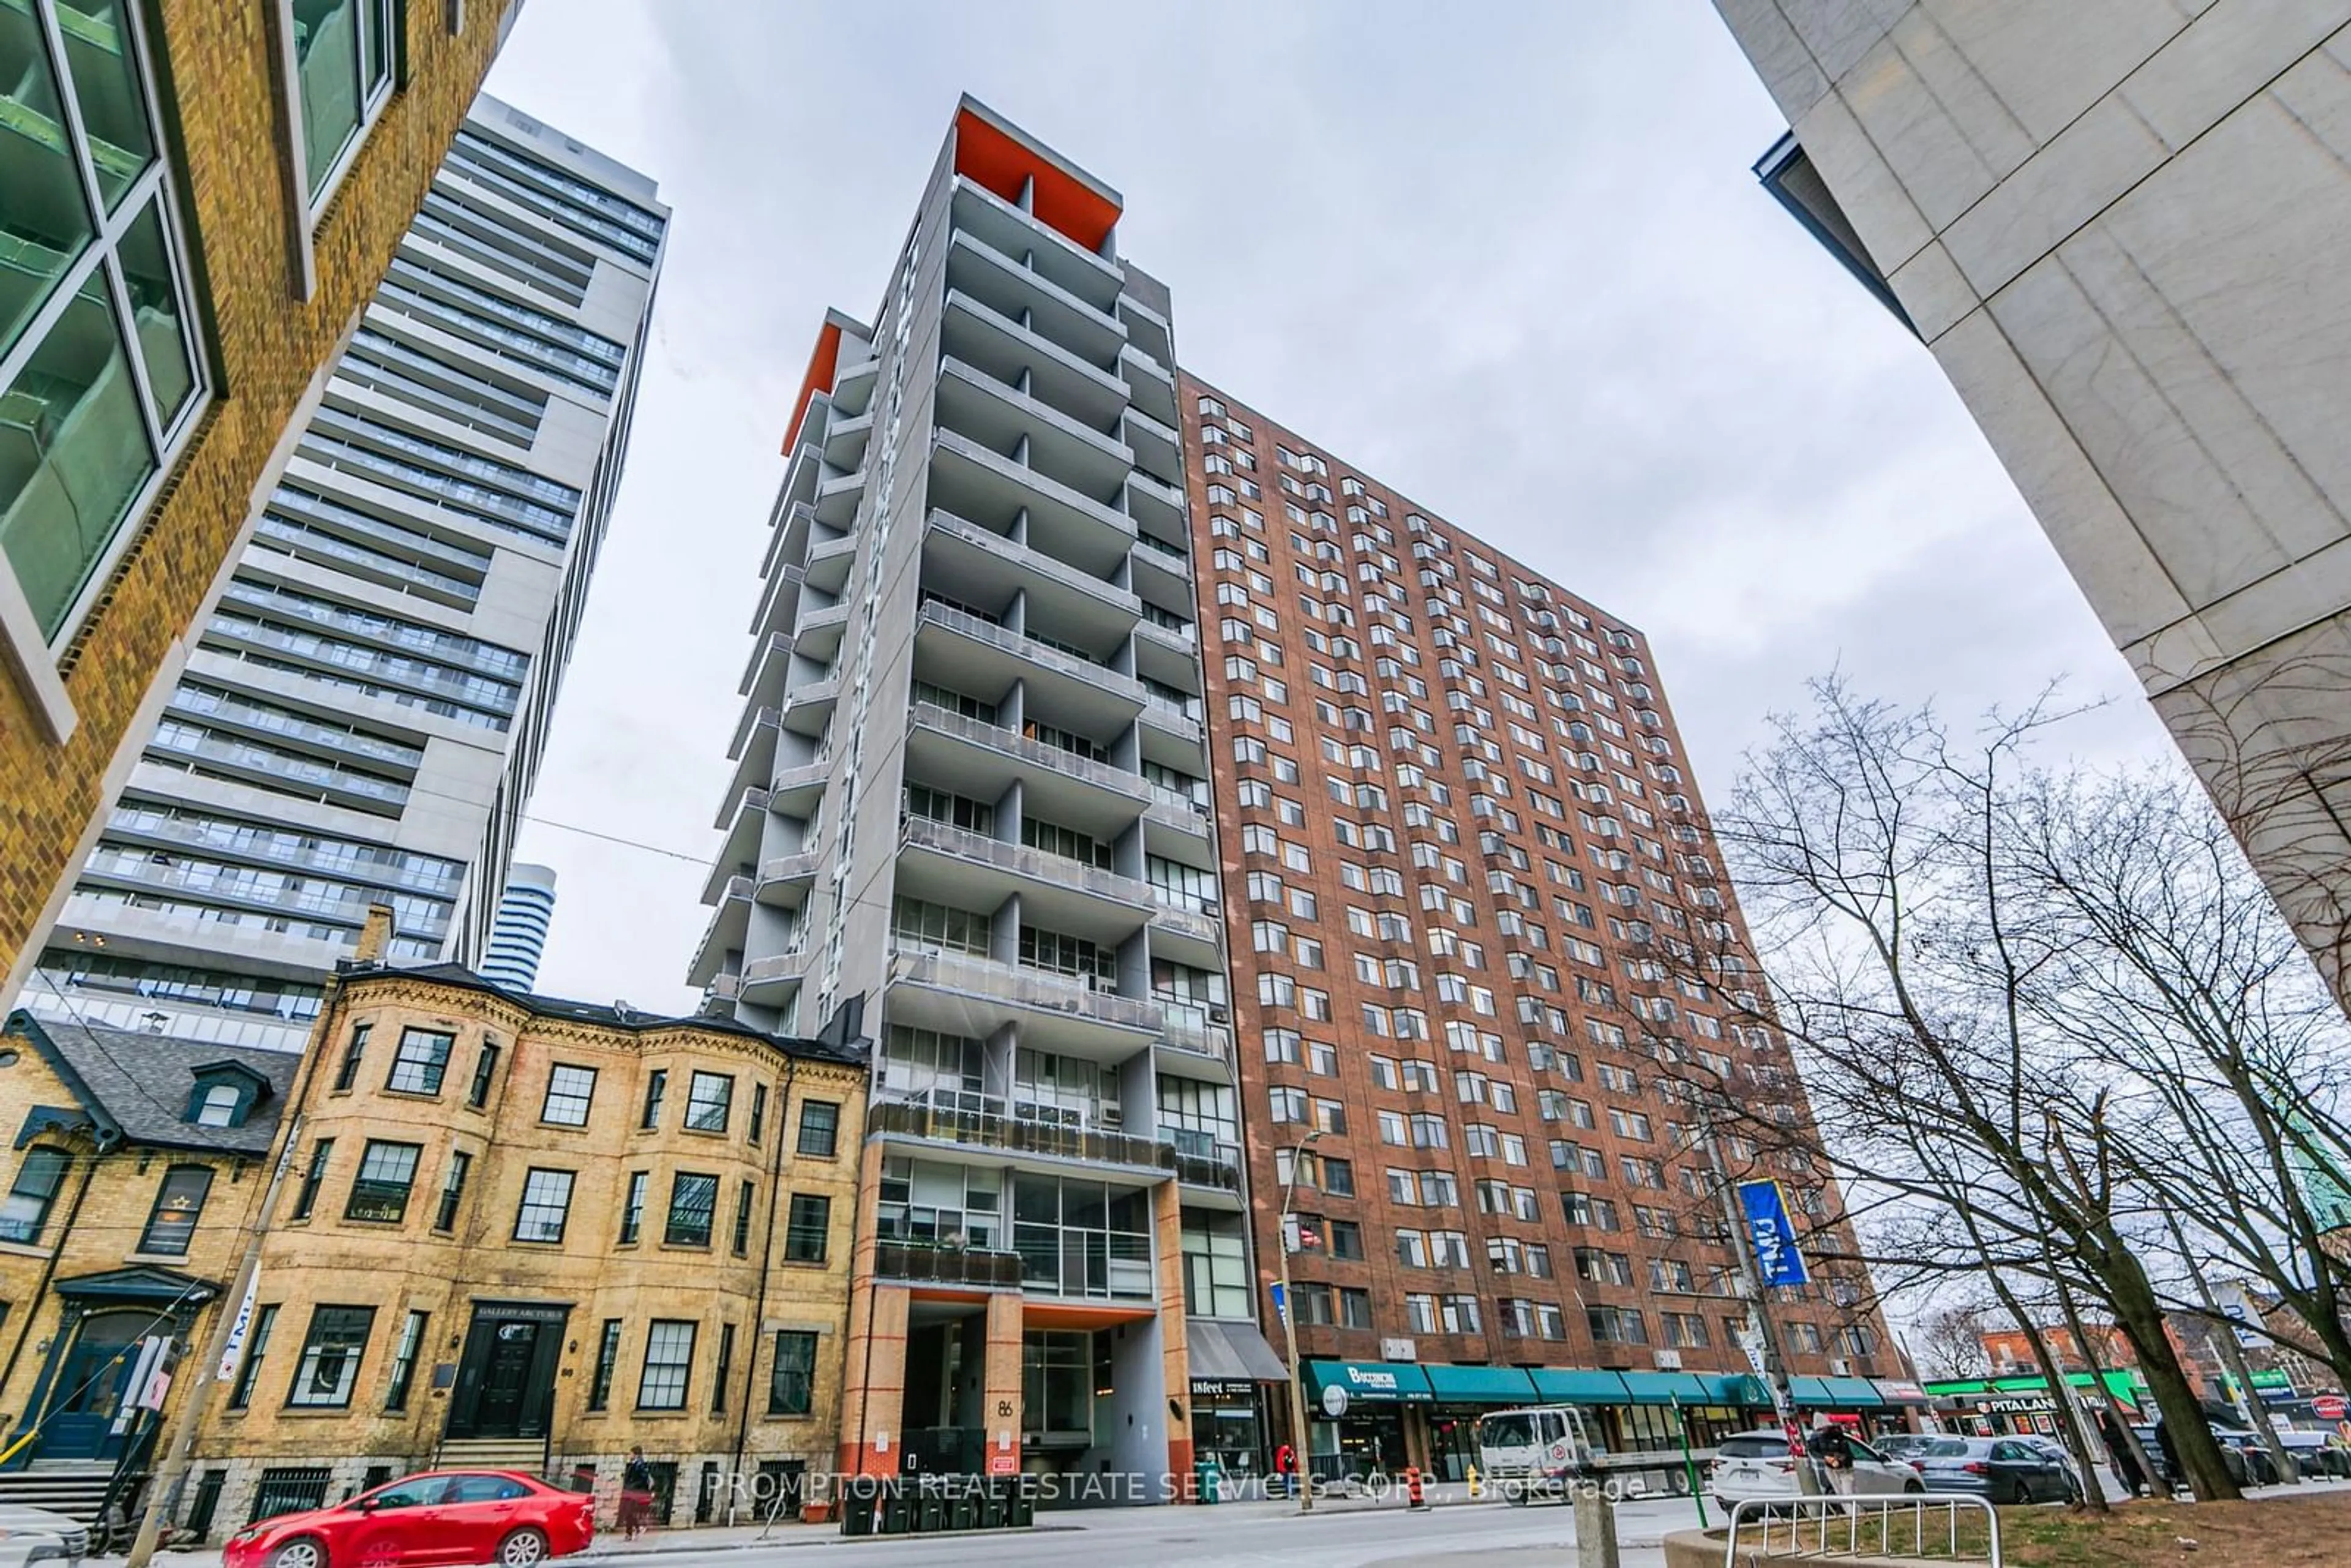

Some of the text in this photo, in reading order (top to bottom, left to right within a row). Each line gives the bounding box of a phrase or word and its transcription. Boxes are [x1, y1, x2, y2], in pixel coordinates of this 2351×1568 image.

[1753, 1217, 1788, 1278] TMU
[2224, 1304, 2257, 1343] TU
[997, 1400, 1013, 1417] 86
